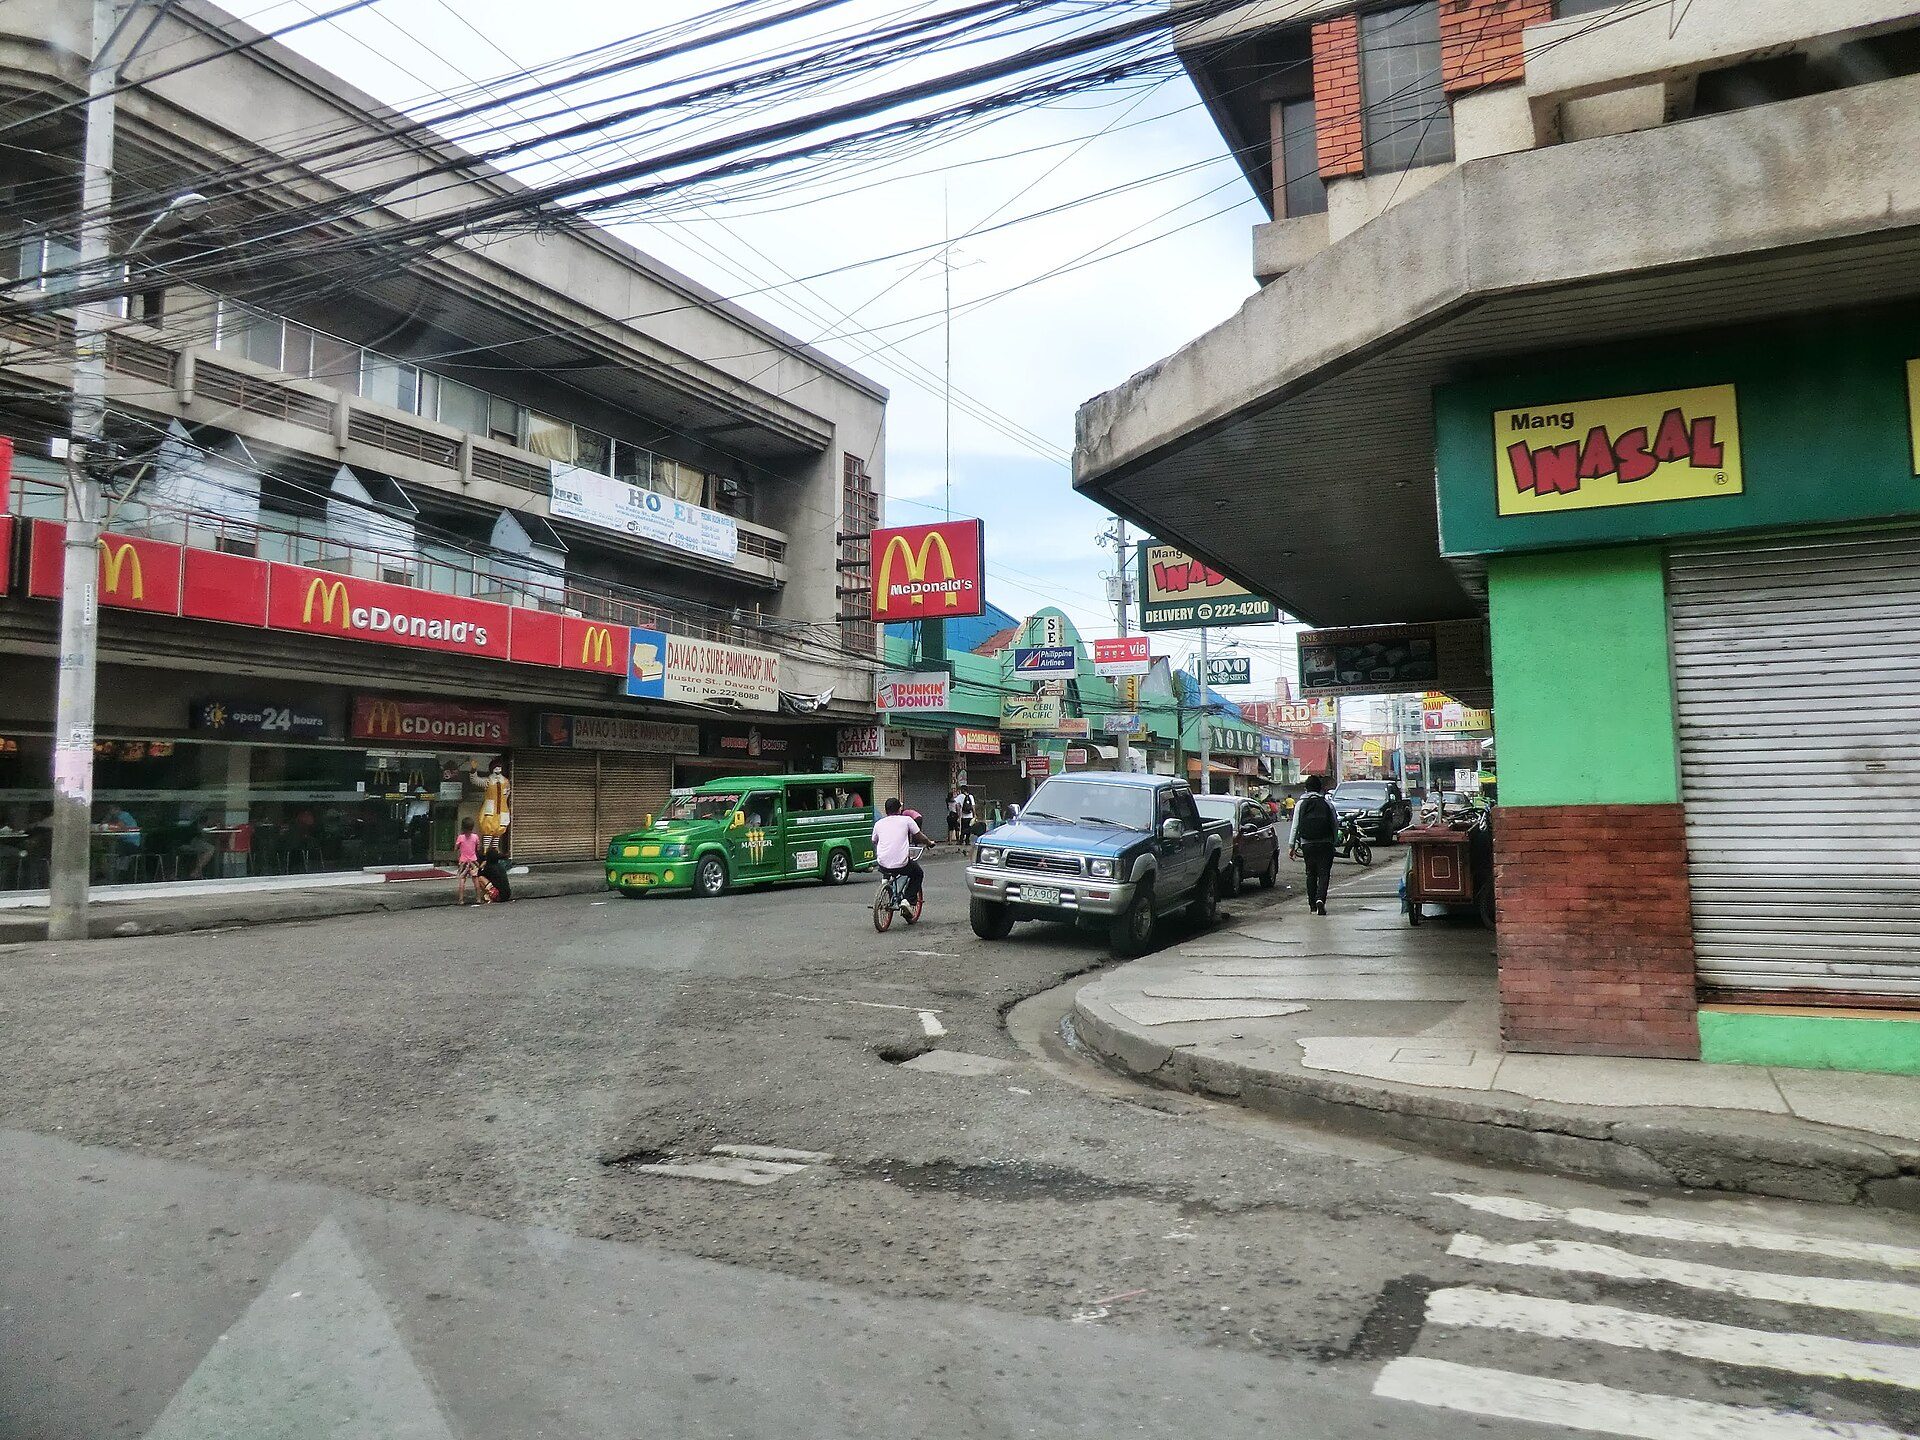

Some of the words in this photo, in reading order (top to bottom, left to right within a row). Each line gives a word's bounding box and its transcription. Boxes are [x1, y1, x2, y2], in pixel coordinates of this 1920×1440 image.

[1511, 412, 1575, 431] Mang
[1506, 406, 1724, 497] INASAL
[1152, 549, 1183, 559] Mang
[1153, 559, 1226, 593] INAS
[890, 578, 973, 596] McDonald's
[303, 578, 488, 646] McDonald's
[1145, 608, 1194, 623] DELIVERY
[1215, 600, 1269, 617] 222-4200
[1300, 633, 1318, 643] ONE
[1041, 650, 1072, 661] Philippine
[1129, 642, 1147, 655] via
[667, 642, 698, 672] DAVAO
[700, 649, 705, 673] 3
[706, 650, 724, 675] SURE
[764, 660, 778, 684] INC.
[1041, 659, 1065, 667] Airlines
[680, 685, 699, 694] Tel.
[725, 680, 755, 691] Davao
[758, 685, 777, 695] City
[897, 682, 945, 696] DUNKIN'
[897, 695, 944, 707] DONUTS
[1033, 703, 1055, 711] CEBU
[232, 713, 262, 724] open
[261, 708, 291, 731] 24
[293, 715, 324, 726] hours
[367, 699, 500, 739] McDonald's
[1022, 711, 1053, 719] PACIFIC
[1282, 705, 1310, 721] RD
[1278, 720, 1312, 728] PAWNSHOP
[1446, 720, 1485, 728] OPTICAL
[841, 726, 878, 740] CAFE
[1212, 727, 1254, 752] NOVO
[839, 739, 879, 753] OPTICAL
[741, 839, 774, 849] MASTER
